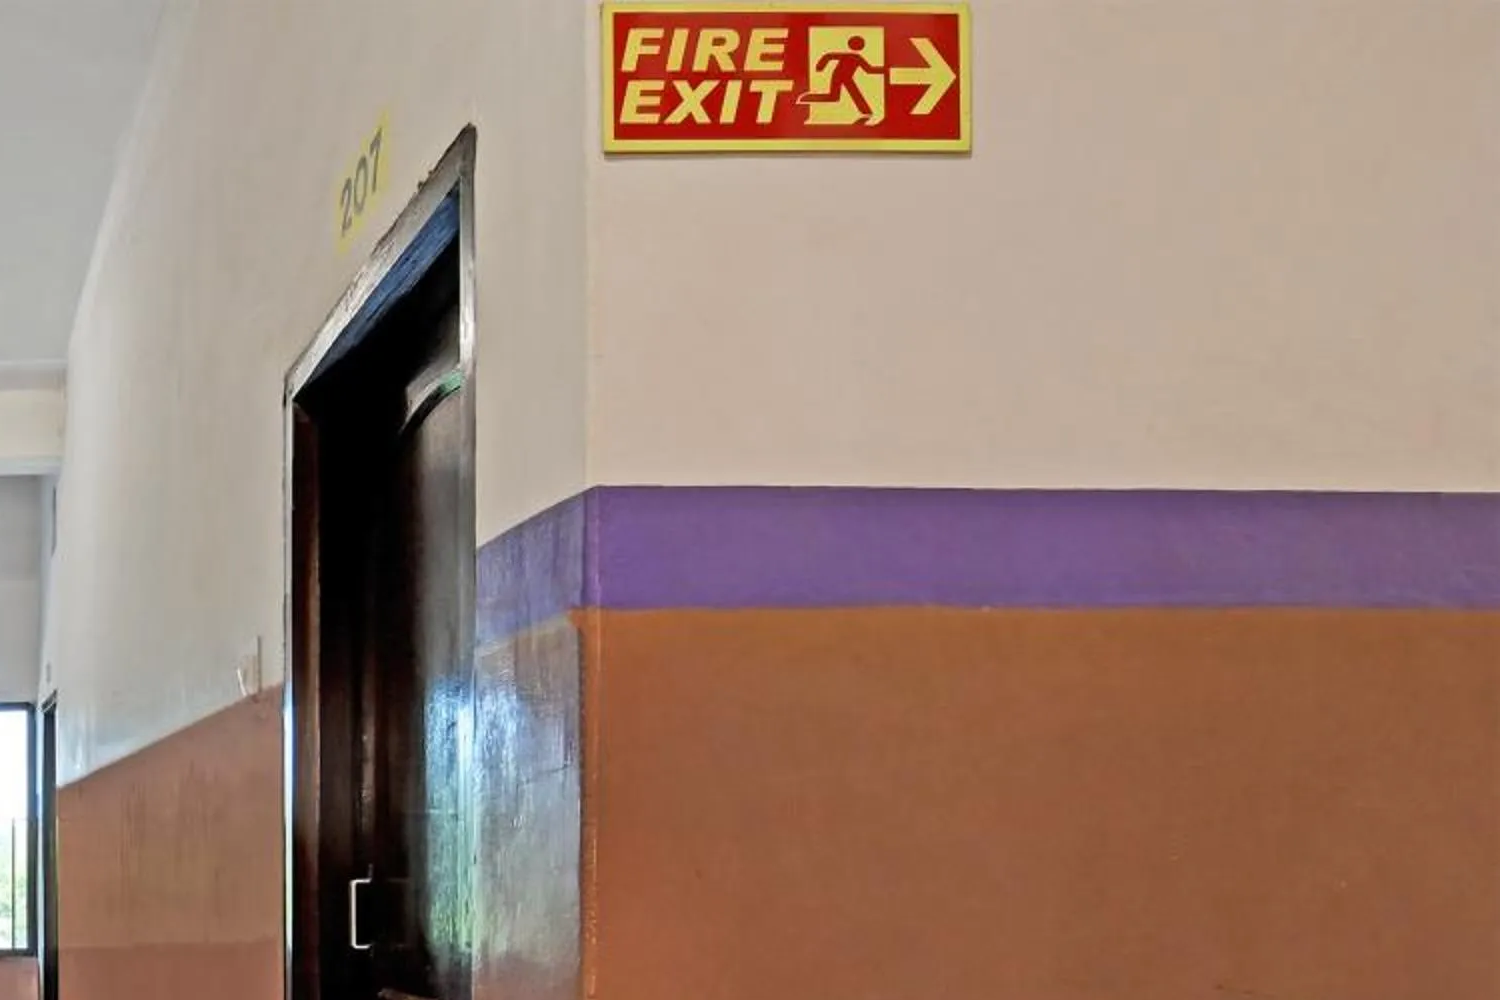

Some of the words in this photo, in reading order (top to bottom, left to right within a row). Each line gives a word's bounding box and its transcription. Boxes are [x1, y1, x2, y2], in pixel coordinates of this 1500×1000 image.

[620, 27, 790, 72] FIRE
[619, 79, 794, 125] EXIT
[340, 126, 382, 238] 207
